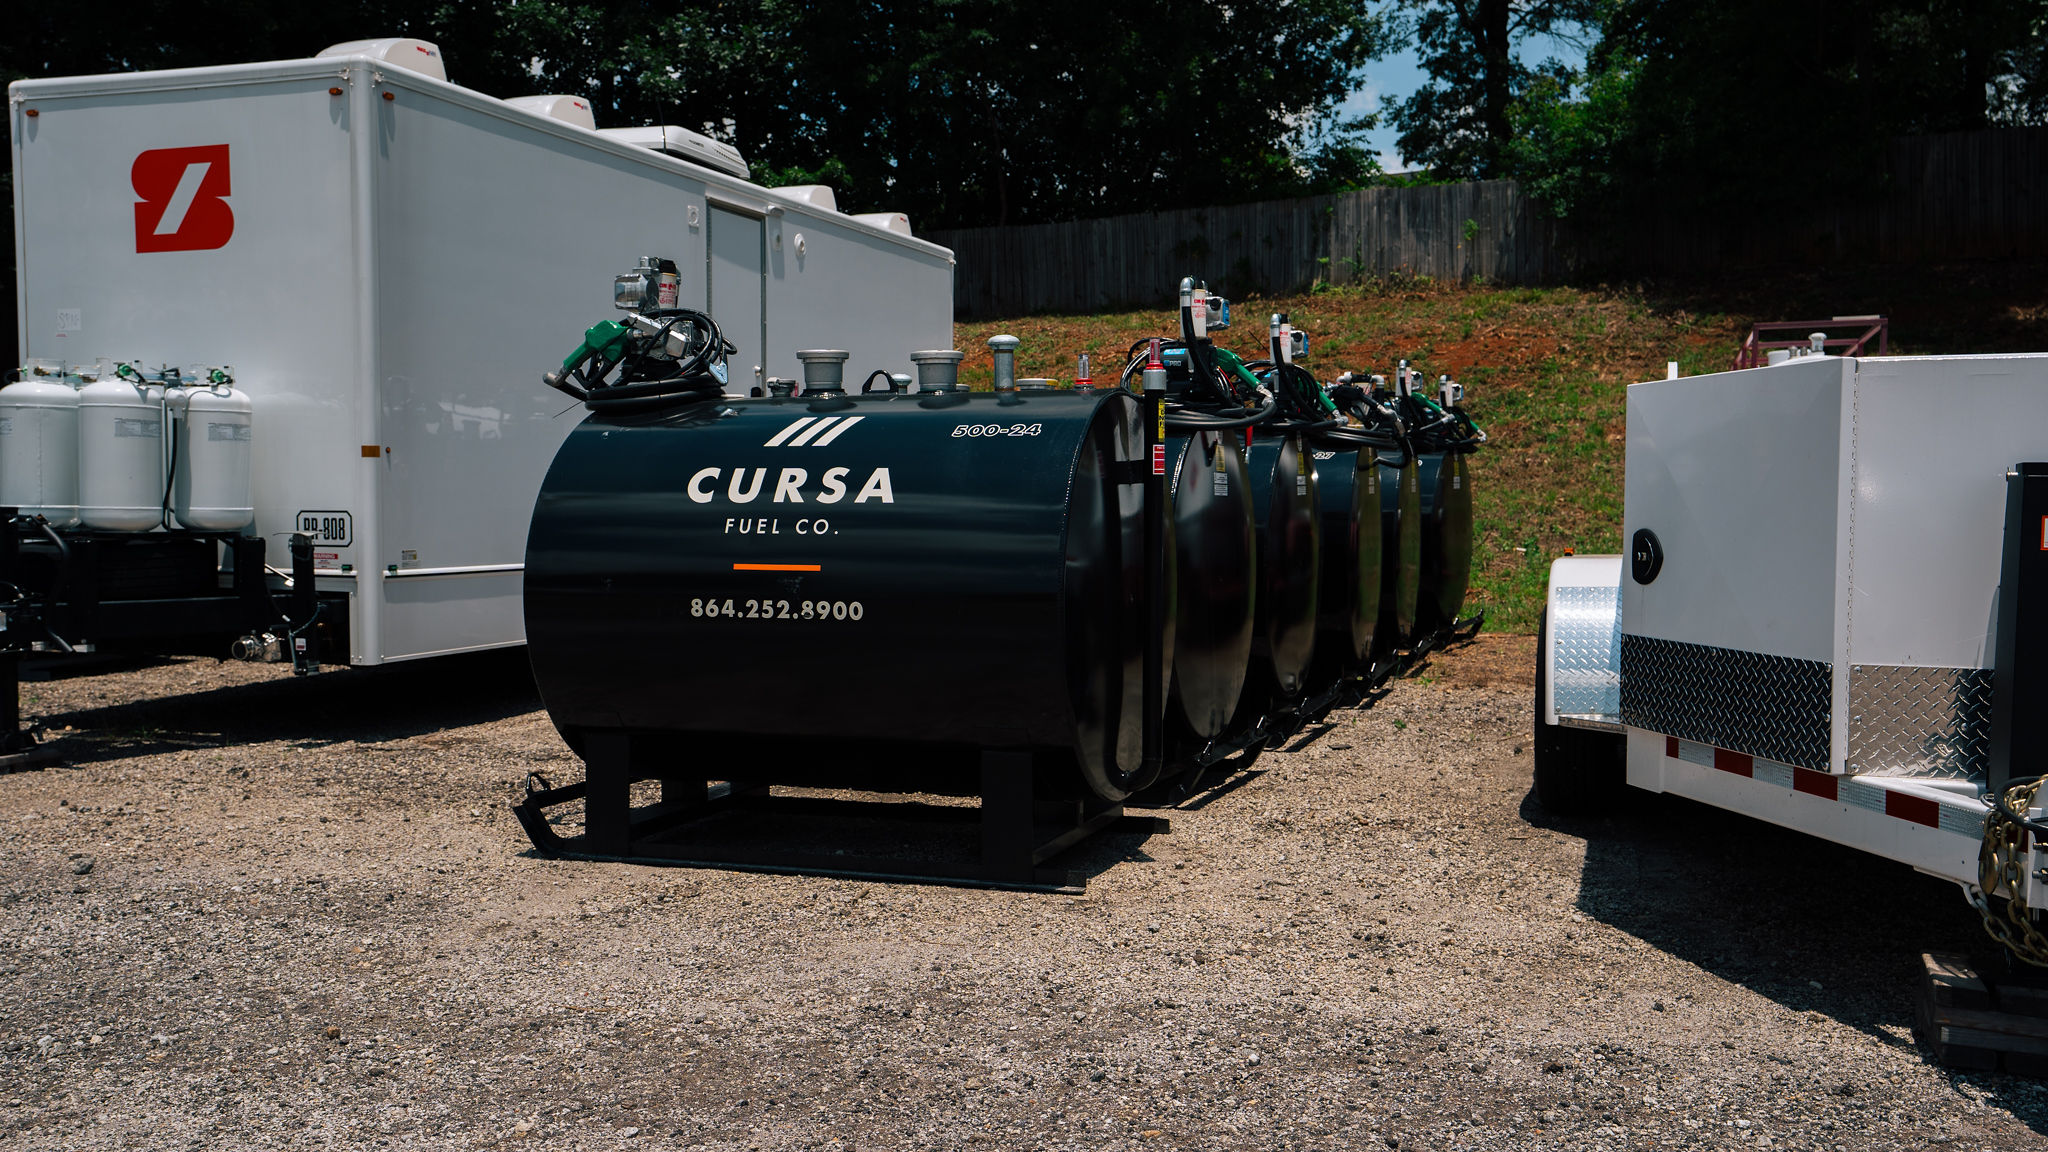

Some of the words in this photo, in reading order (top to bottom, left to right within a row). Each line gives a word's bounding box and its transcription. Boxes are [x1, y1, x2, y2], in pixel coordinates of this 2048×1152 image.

[951, 423, 1042, 438] 500-24
[687, 467, 895, 504] CURSA
[724, 518, 780, 534] FUEL
[795, 518, 839, 535] CO.
[690, 598, 864, 621] 864.252.8900
